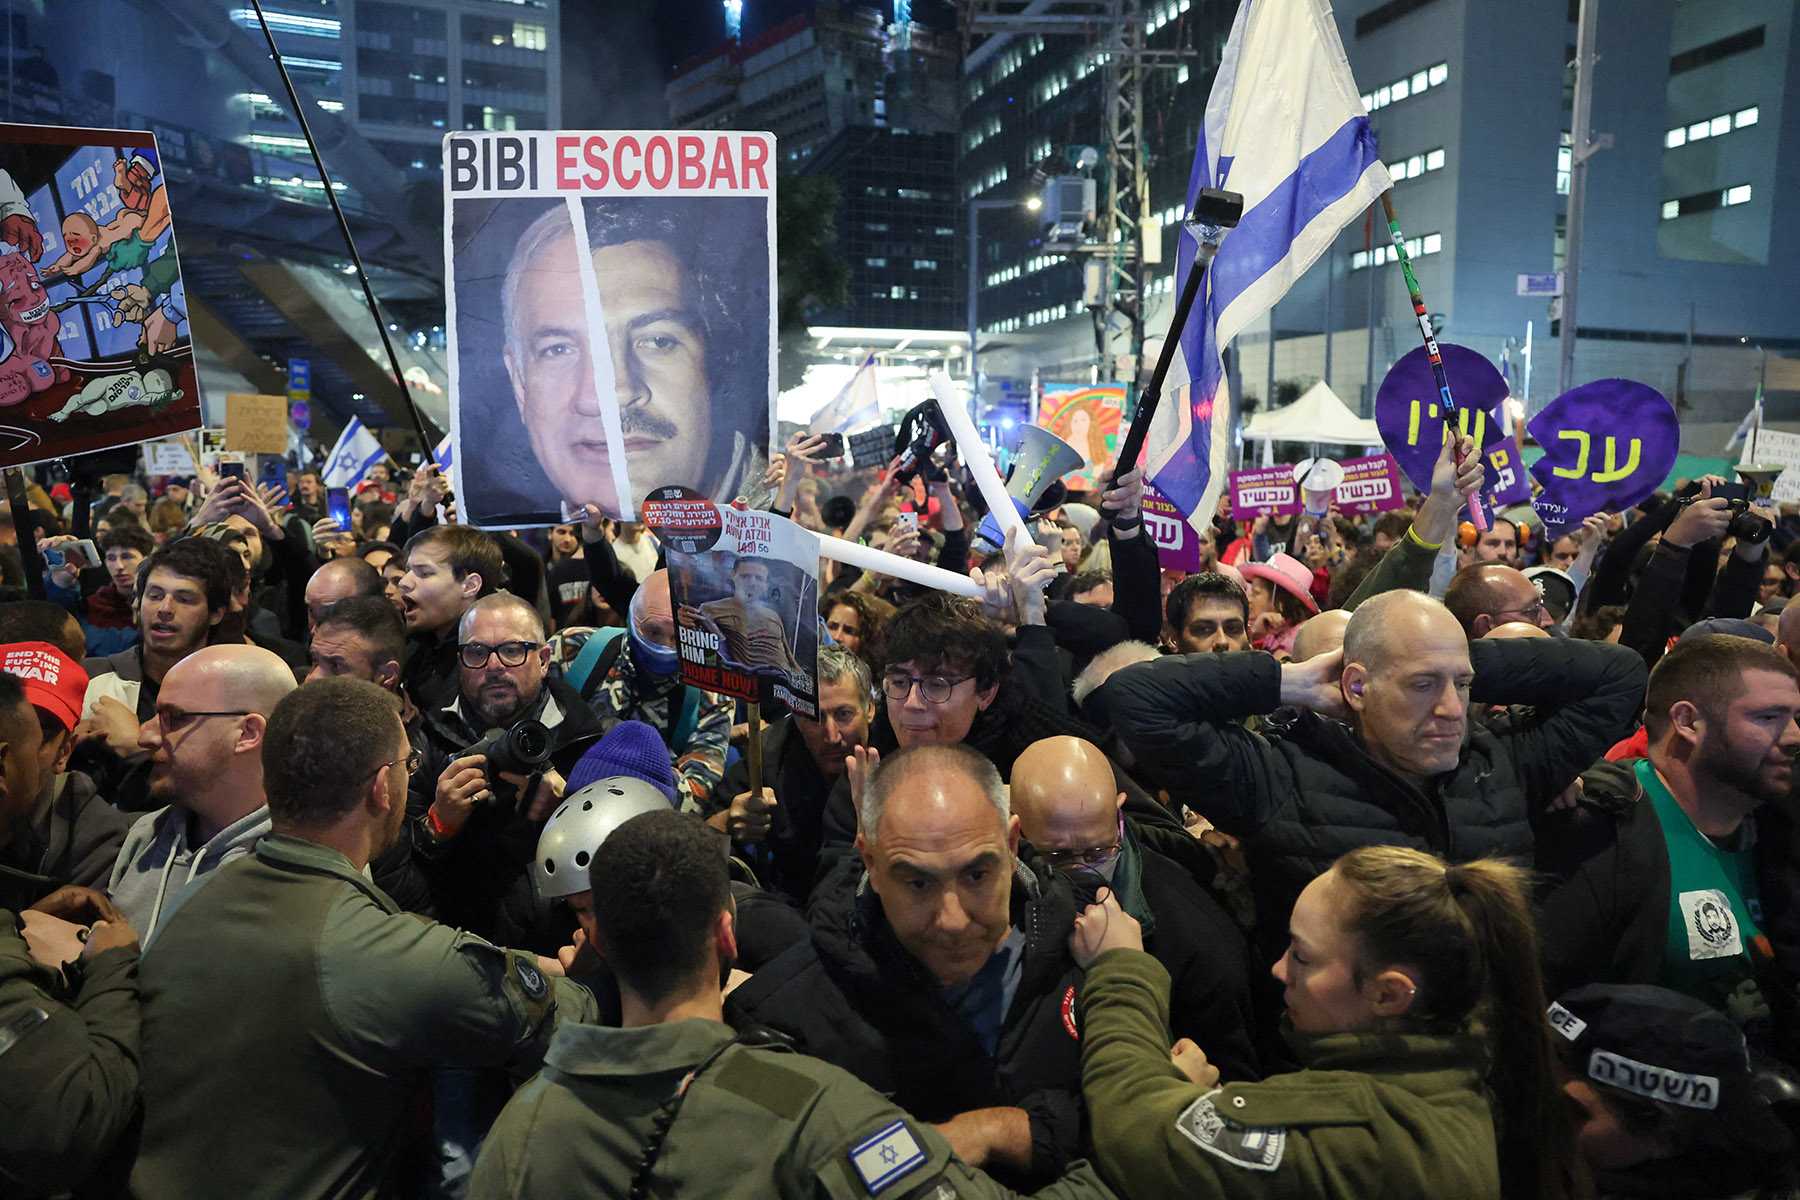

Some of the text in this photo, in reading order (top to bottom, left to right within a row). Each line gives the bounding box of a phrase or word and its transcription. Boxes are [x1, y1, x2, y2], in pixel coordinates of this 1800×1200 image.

[450, 136, 769, 191] BIBI ESCOBAR
[1553, 430, 1642, 483] עכ
[1242, 490, 1290, 503] עכשיו
[1340, 482, 1387, 499] עכשיו
[686, 510, 715, 518] חקירה
[745, 529, 771, 542] ATZILI
[758, 543, 769, 553] 50
[679, 625, 719, 650] BRING
[36, 651, 60, 665] THIS
[681, 643, 705, 665] HIM
[3, 666, 58, 686] WAR
[682, 661, 758, 695] HOME NOW!
[1596, 1055, 1711, 1102] משטרה
